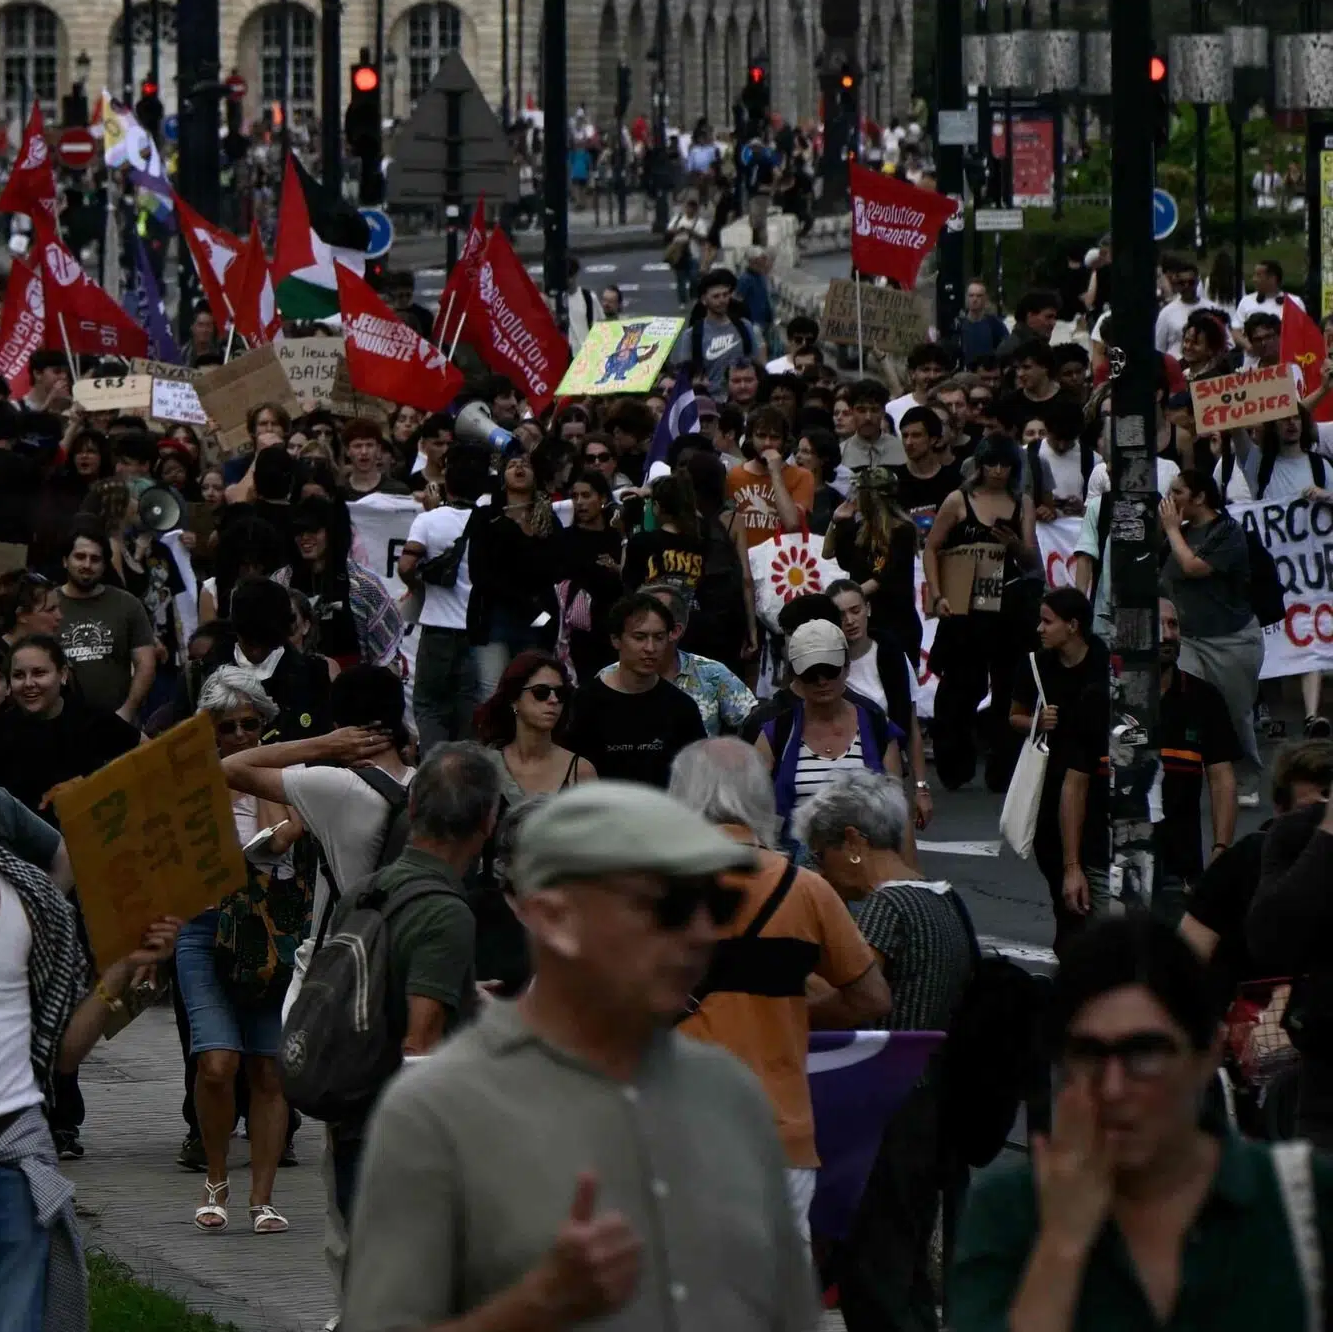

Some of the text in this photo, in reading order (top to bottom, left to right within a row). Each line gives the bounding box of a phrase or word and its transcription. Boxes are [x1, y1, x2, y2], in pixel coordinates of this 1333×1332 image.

[867, 199, 926, 228] Révolution
[871, 225, 928, 249] rmanente
[710, 333, 735, 351] NIKE
[93, 378, 124, 389] CRS
[1195, 363, 1288, 400] SURVIVRE
[1221, 390, 1247, 403] OU
[1202, 394, 1291, 427] ÉTUDIER
